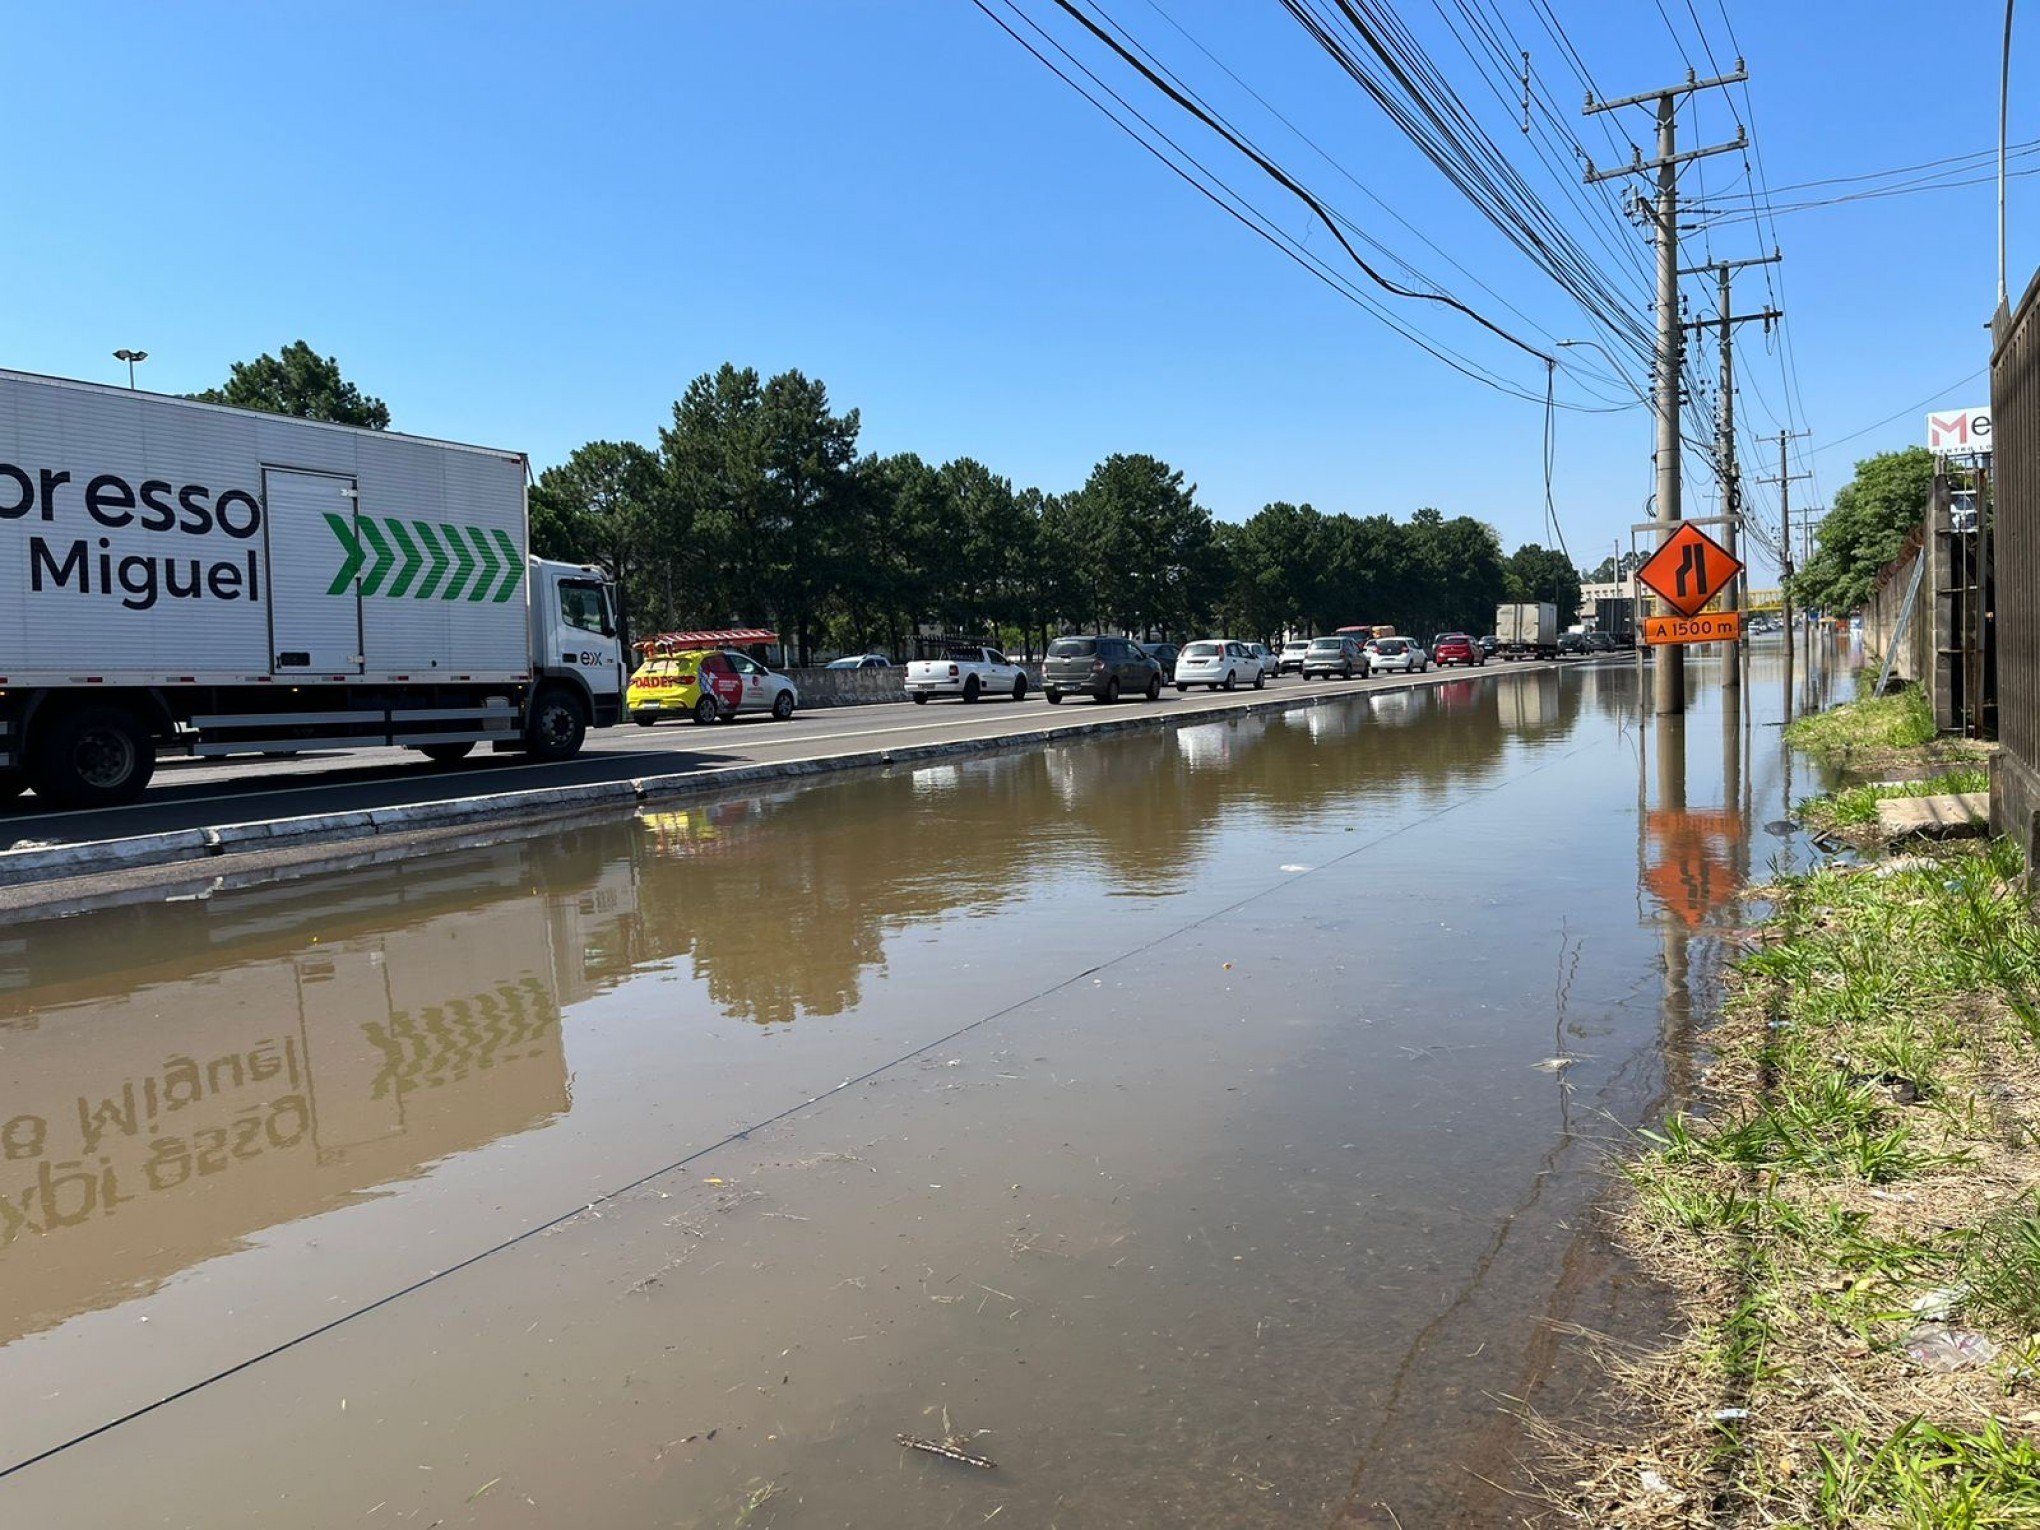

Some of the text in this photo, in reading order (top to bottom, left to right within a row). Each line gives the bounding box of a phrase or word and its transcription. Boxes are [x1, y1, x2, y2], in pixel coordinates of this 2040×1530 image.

[30, 536, 258, 610] Miguel
[1656, 621, 1732, 637] A 1500 m
